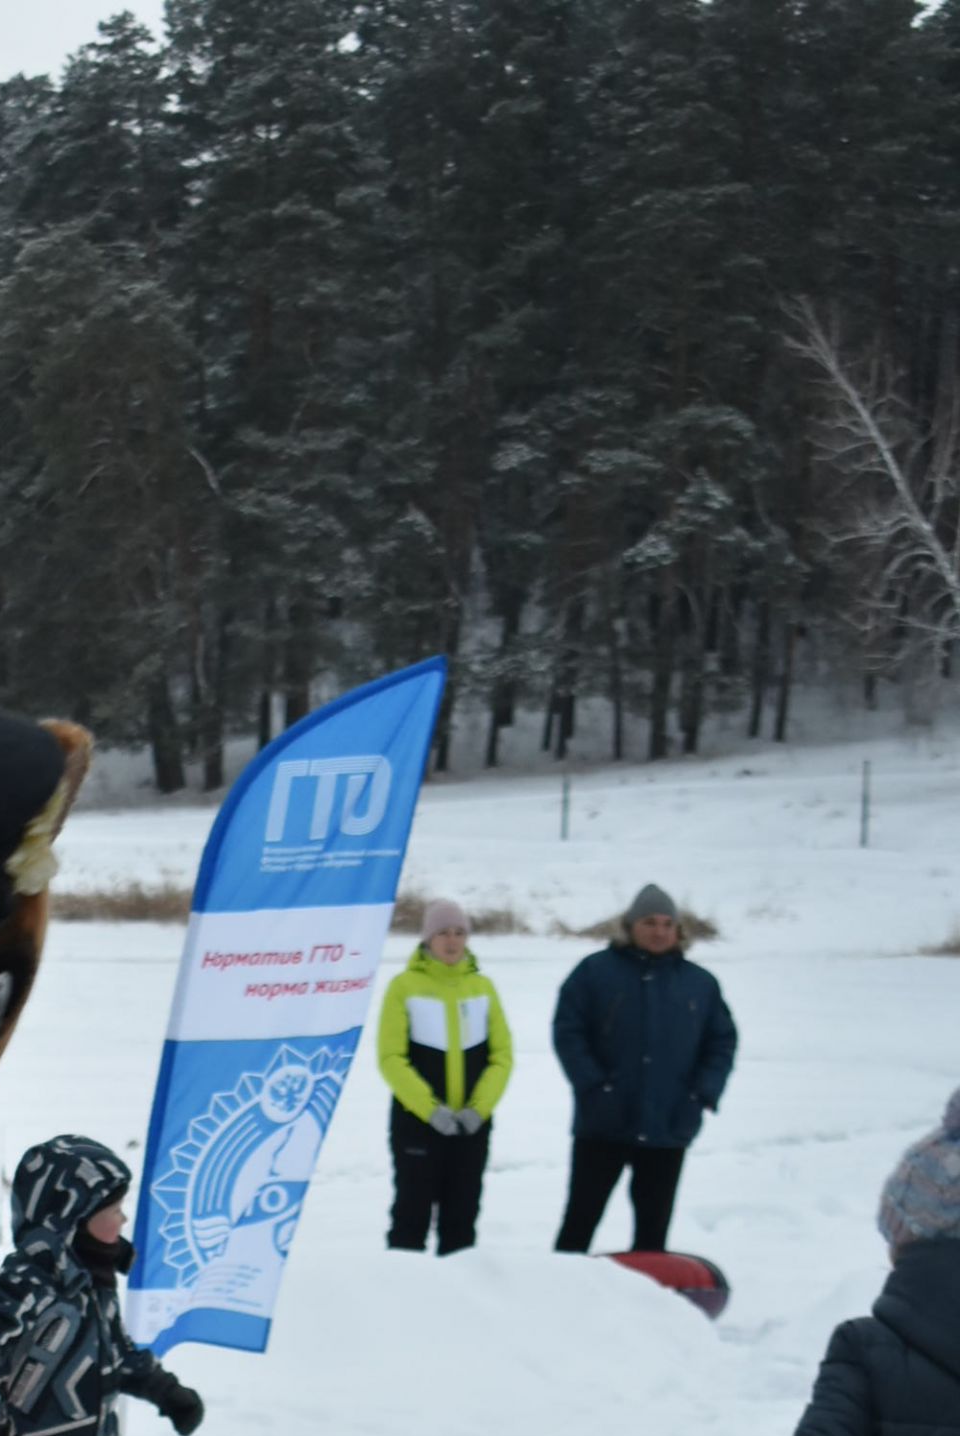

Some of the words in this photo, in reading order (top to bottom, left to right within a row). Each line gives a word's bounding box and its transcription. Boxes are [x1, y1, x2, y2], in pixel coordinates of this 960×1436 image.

[265, 755, 393, 842] ГТО
[201, 951, 303, 972] Норматив
[308, 944, 344, 963] ГТО
[244, 981, 308, 1000] норма
